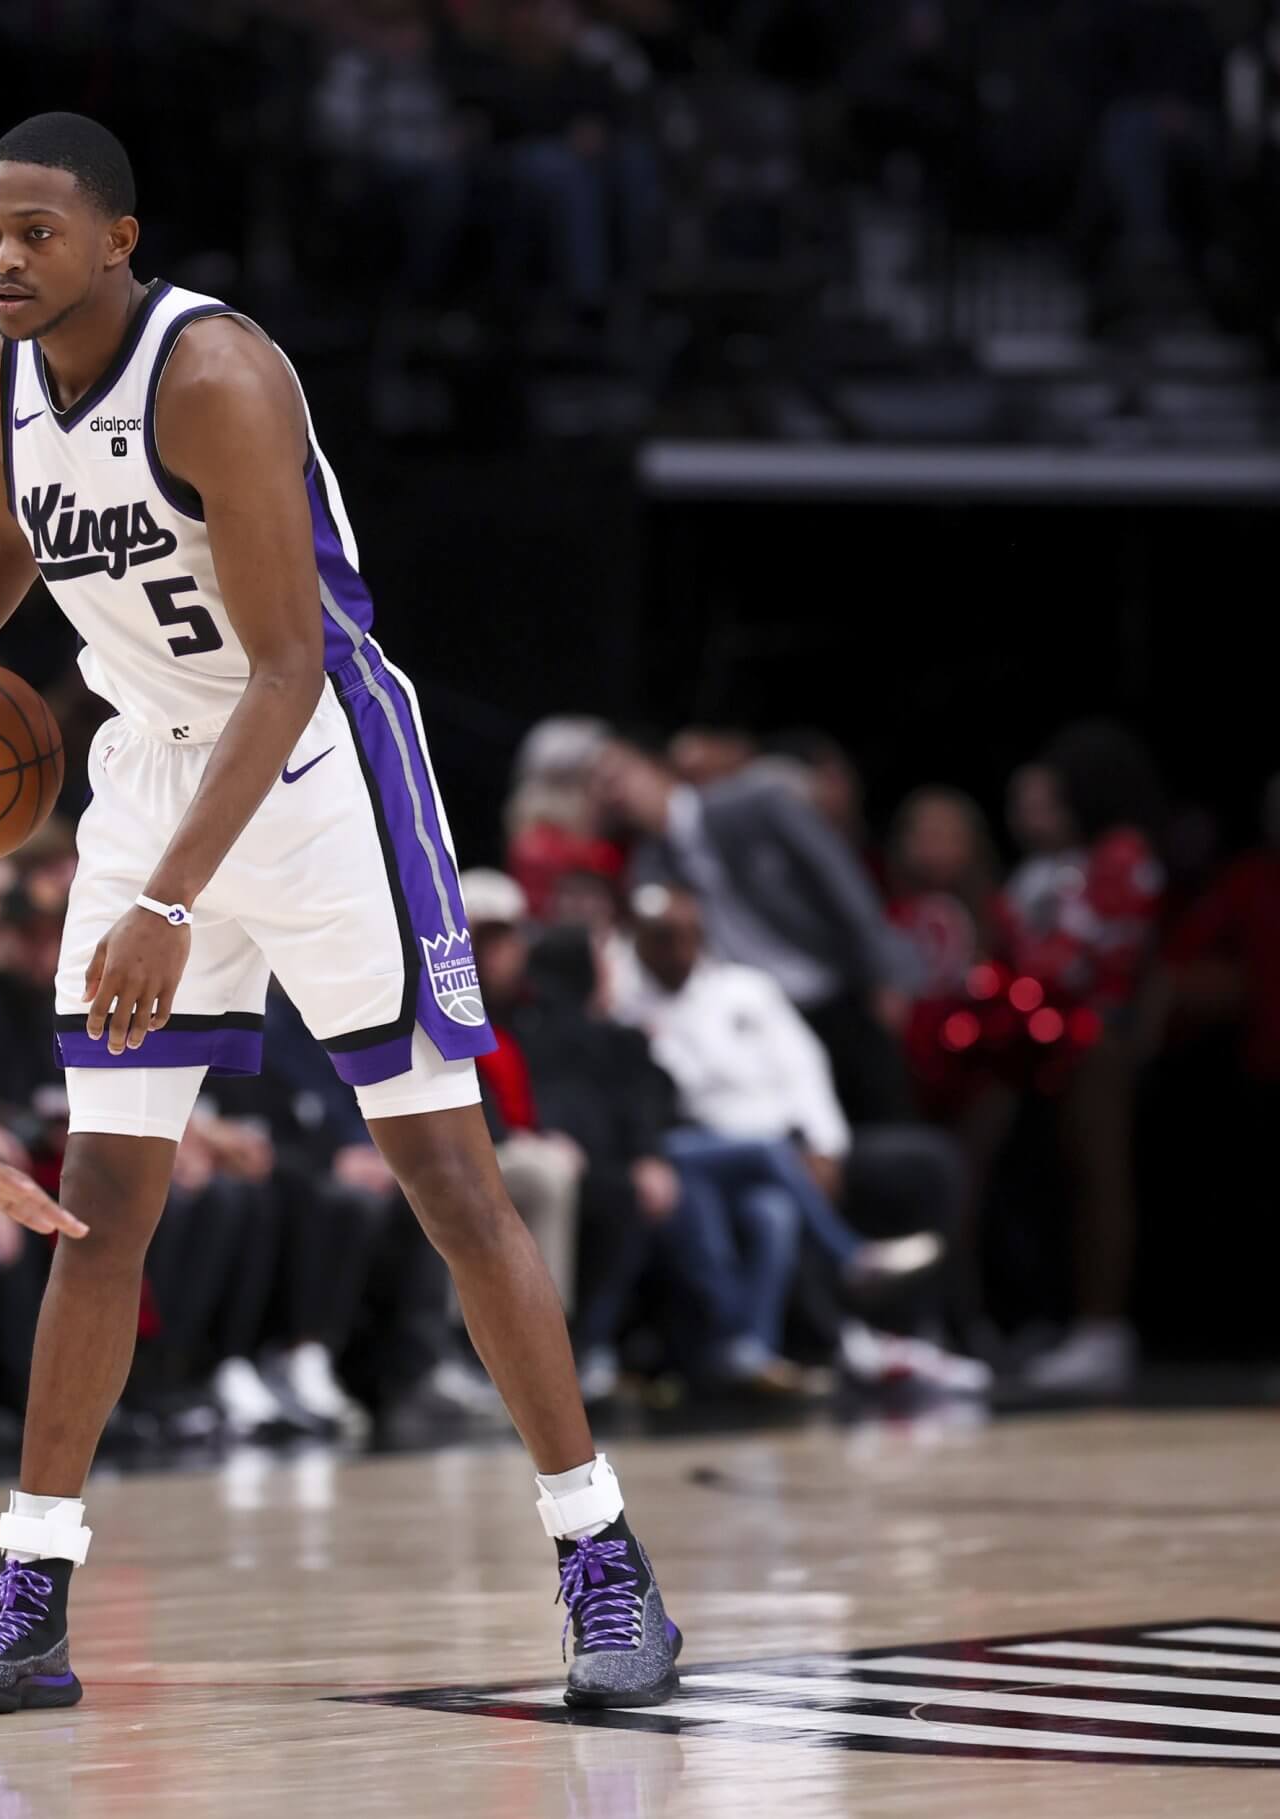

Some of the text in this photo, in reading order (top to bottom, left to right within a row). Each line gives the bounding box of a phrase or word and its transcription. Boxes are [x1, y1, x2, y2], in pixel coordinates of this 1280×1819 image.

[21, 483, 178, 581] Kings
[142, 576, 223, 657] 5
[433, 955, 474, 971] SACRAME
